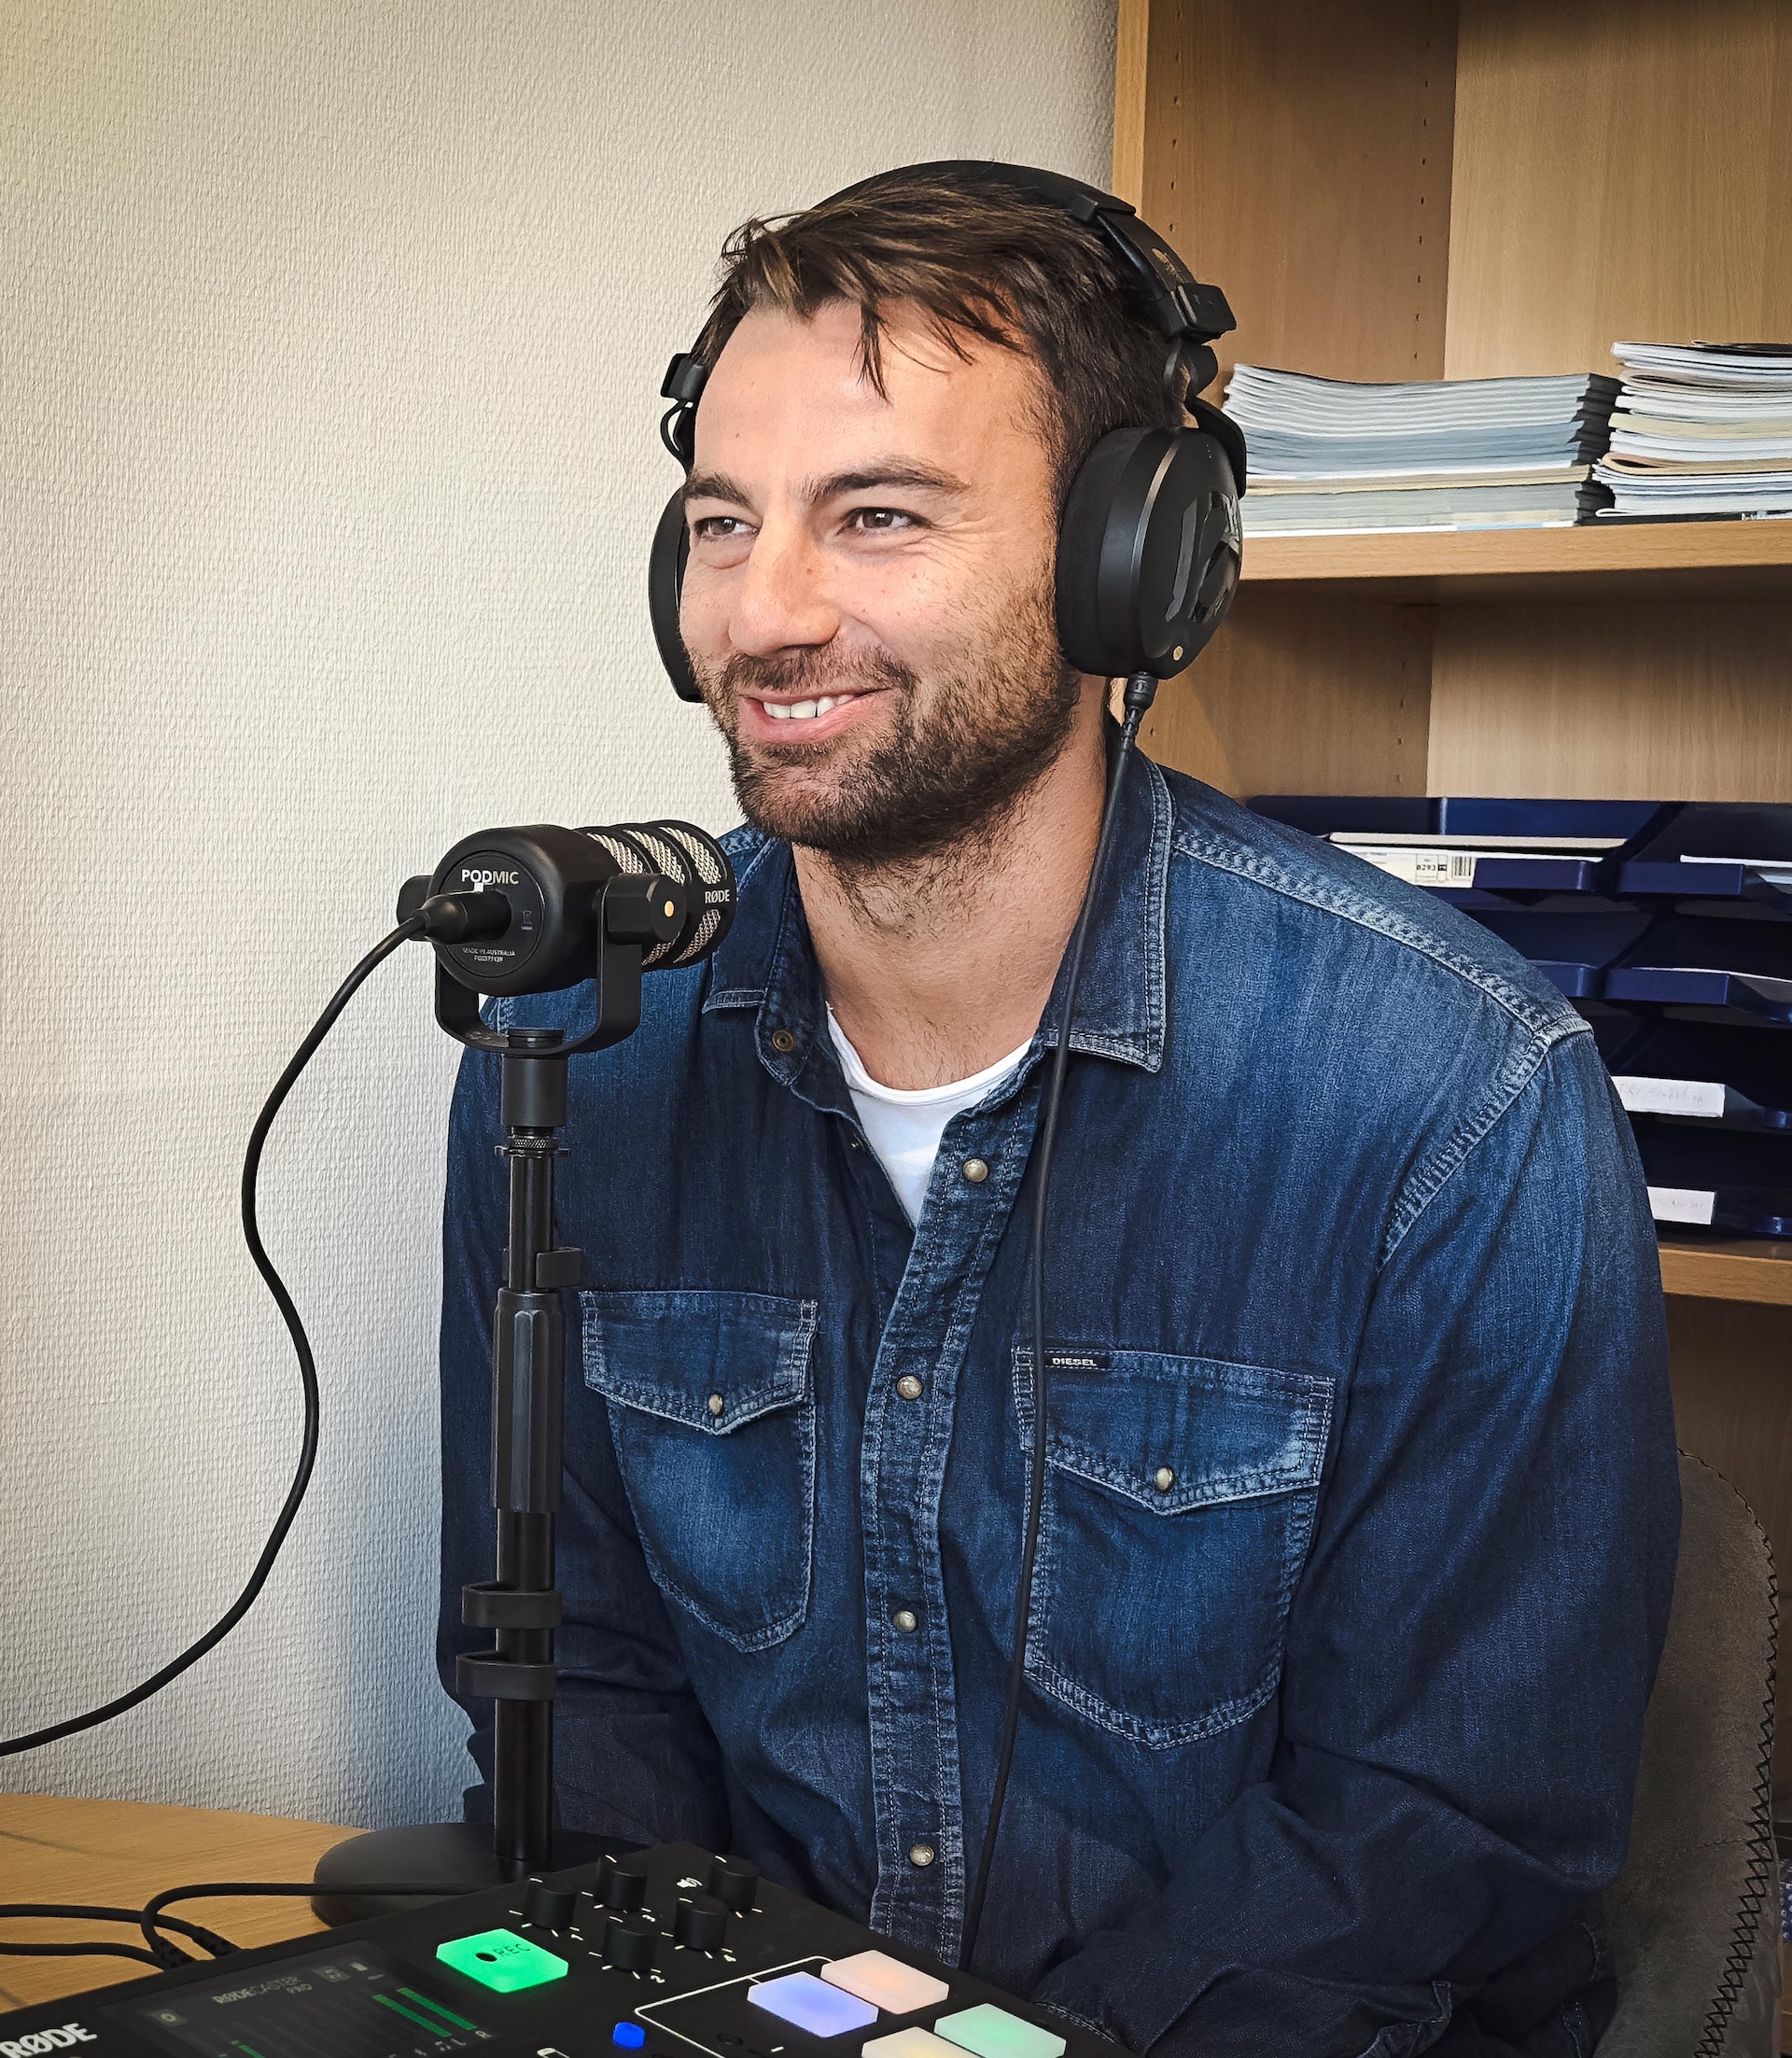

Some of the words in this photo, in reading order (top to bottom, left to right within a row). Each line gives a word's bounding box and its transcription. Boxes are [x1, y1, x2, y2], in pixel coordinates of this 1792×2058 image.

[461, 869, 519, 885] PODMIC
[705, 889, 730, 903] RØDE
[1052, 1357, 1098, 1366] DIESEL
[493, 1943, 531, 1957] REC
[0, 2023, 98, 2058] RØDE
